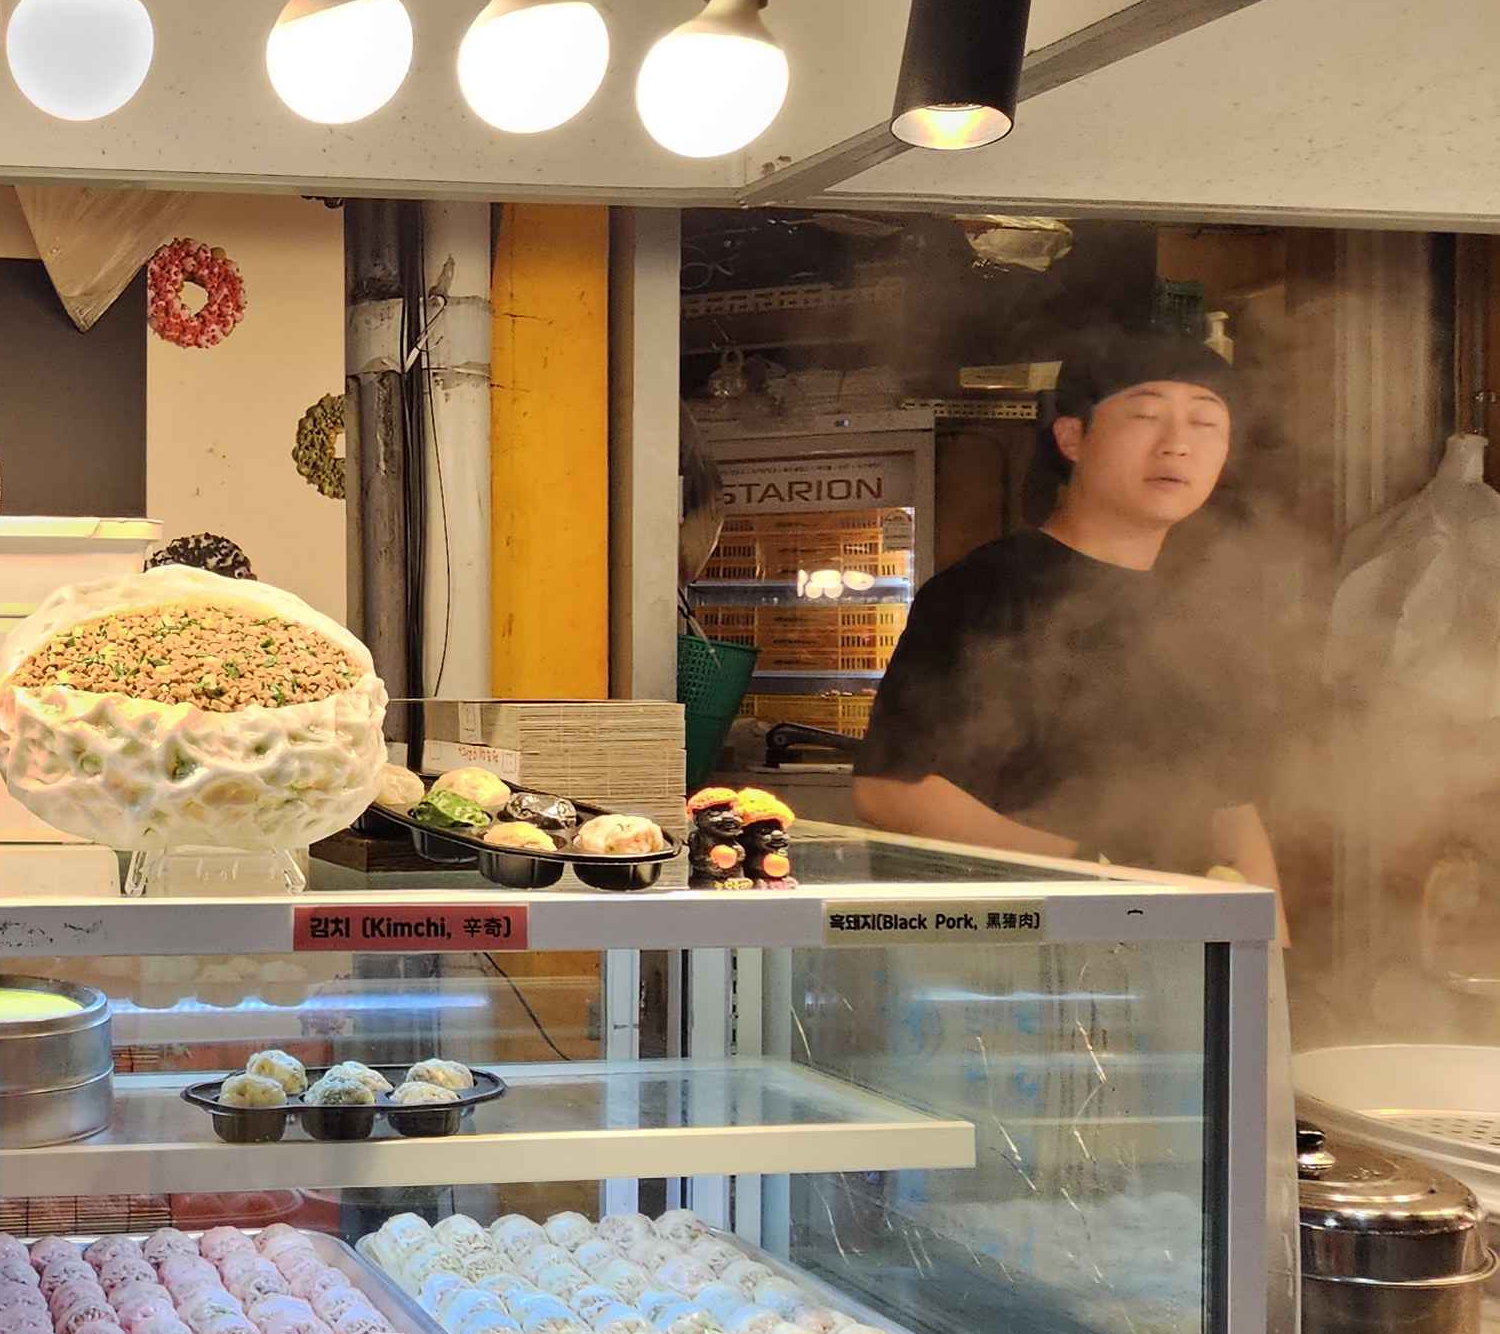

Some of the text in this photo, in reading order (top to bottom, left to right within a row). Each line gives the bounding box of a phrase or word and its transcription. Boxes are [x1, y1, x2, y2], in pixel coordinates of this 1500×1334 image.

[718, 478, 882, 505] STARION
[310, 917, 350, 939] 김치
[362, 917, 452, 940] (Kimchi,
[935, 913, 978, 931] Pork,
